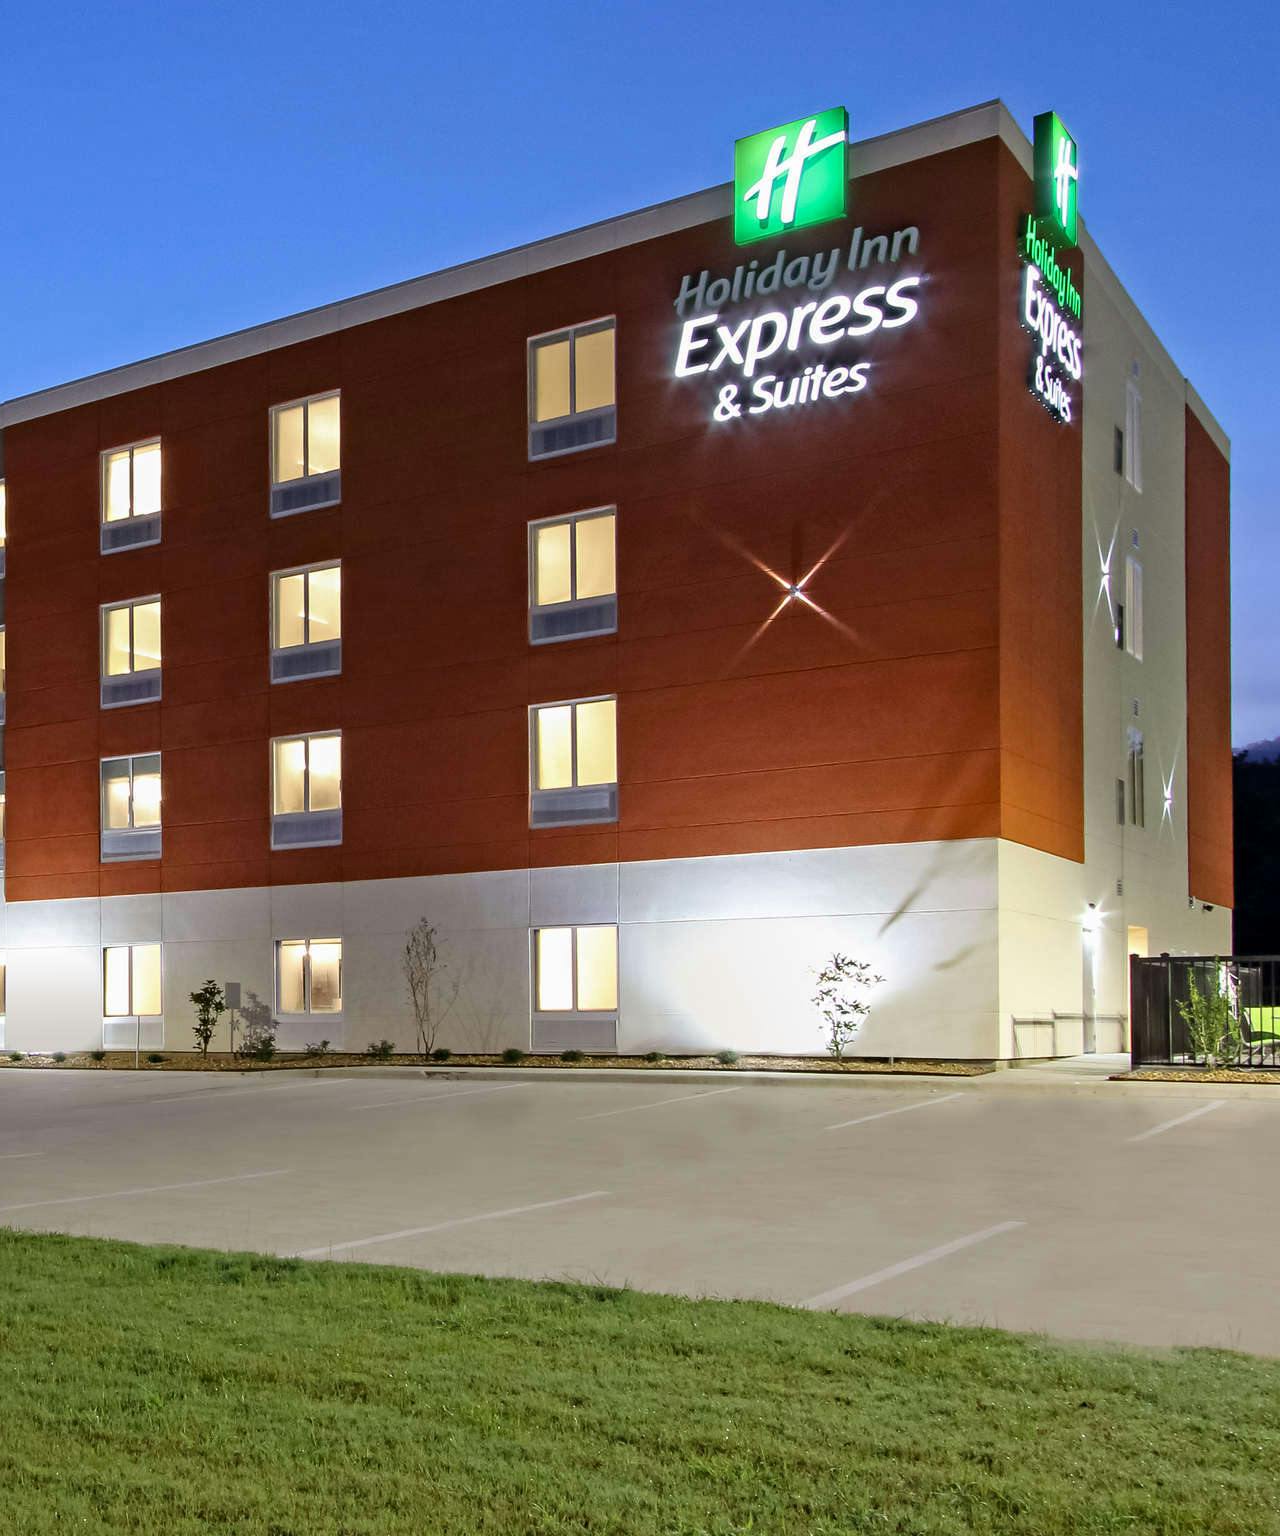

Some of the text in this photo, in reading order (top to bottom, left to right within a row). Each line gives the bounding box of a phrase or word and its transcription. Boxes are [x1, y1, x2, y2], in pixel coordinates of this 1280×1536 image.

[743, 119, 846, 224] H
[1054, 136, 1078, 228] H
[673, 225, 920, 316] Holiday Inn
[1025, 213, 1081, 319] Holiday Inn
[674, 276, 921, 378] Express
[1024, 264, 1081, 380] Express
[712, 362, 871, 422] & Suites
[1035, 354, 1071, 423] & Suites
